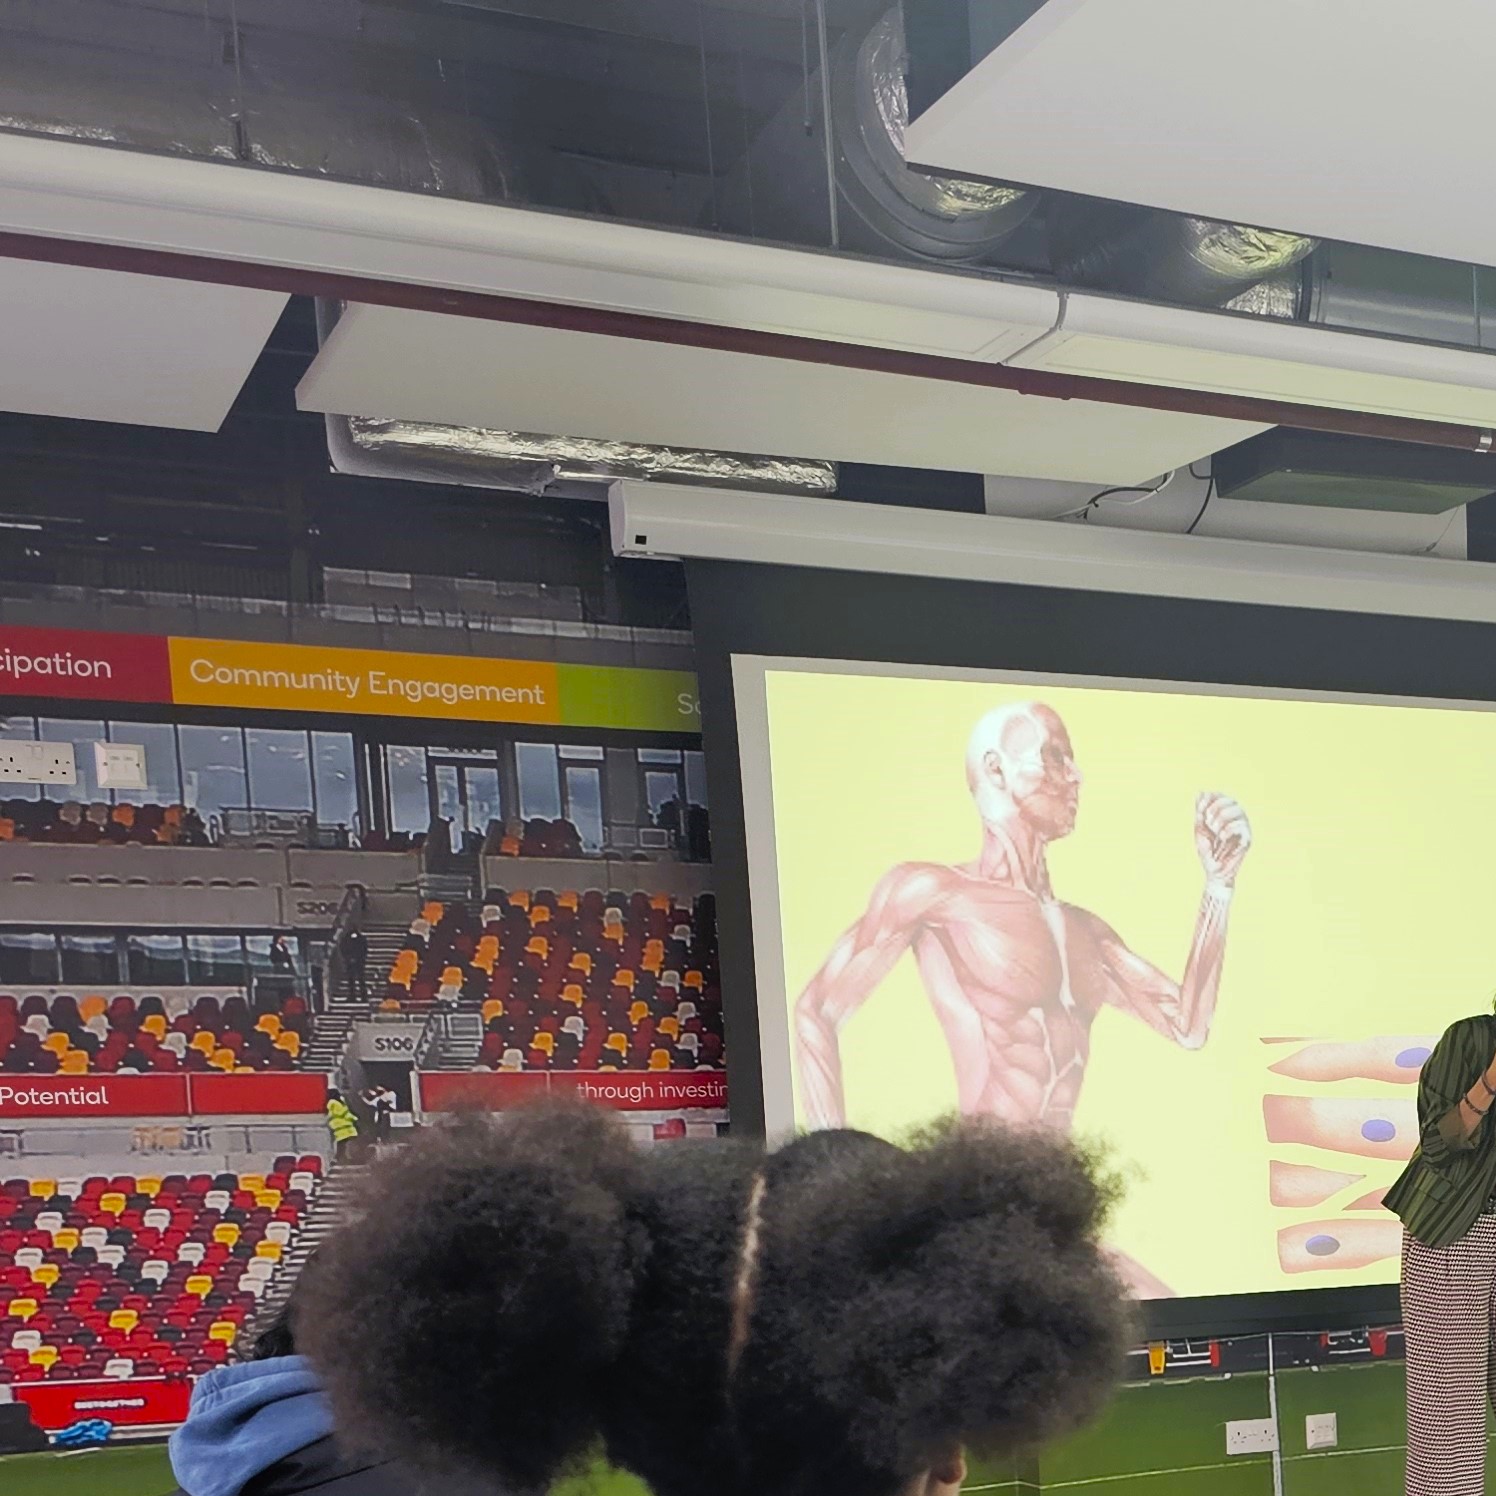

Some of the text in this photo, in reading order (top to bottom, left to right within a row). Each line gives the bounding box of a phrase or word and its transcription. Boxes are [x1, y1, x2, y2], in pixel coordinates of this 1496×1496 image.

[0, 648, 112, 678] ipation
[190, 659, 545, 704] Community Engagement
[0, 1086, 109, 1105] Potential
[576, 1081, 653, 1102] through
